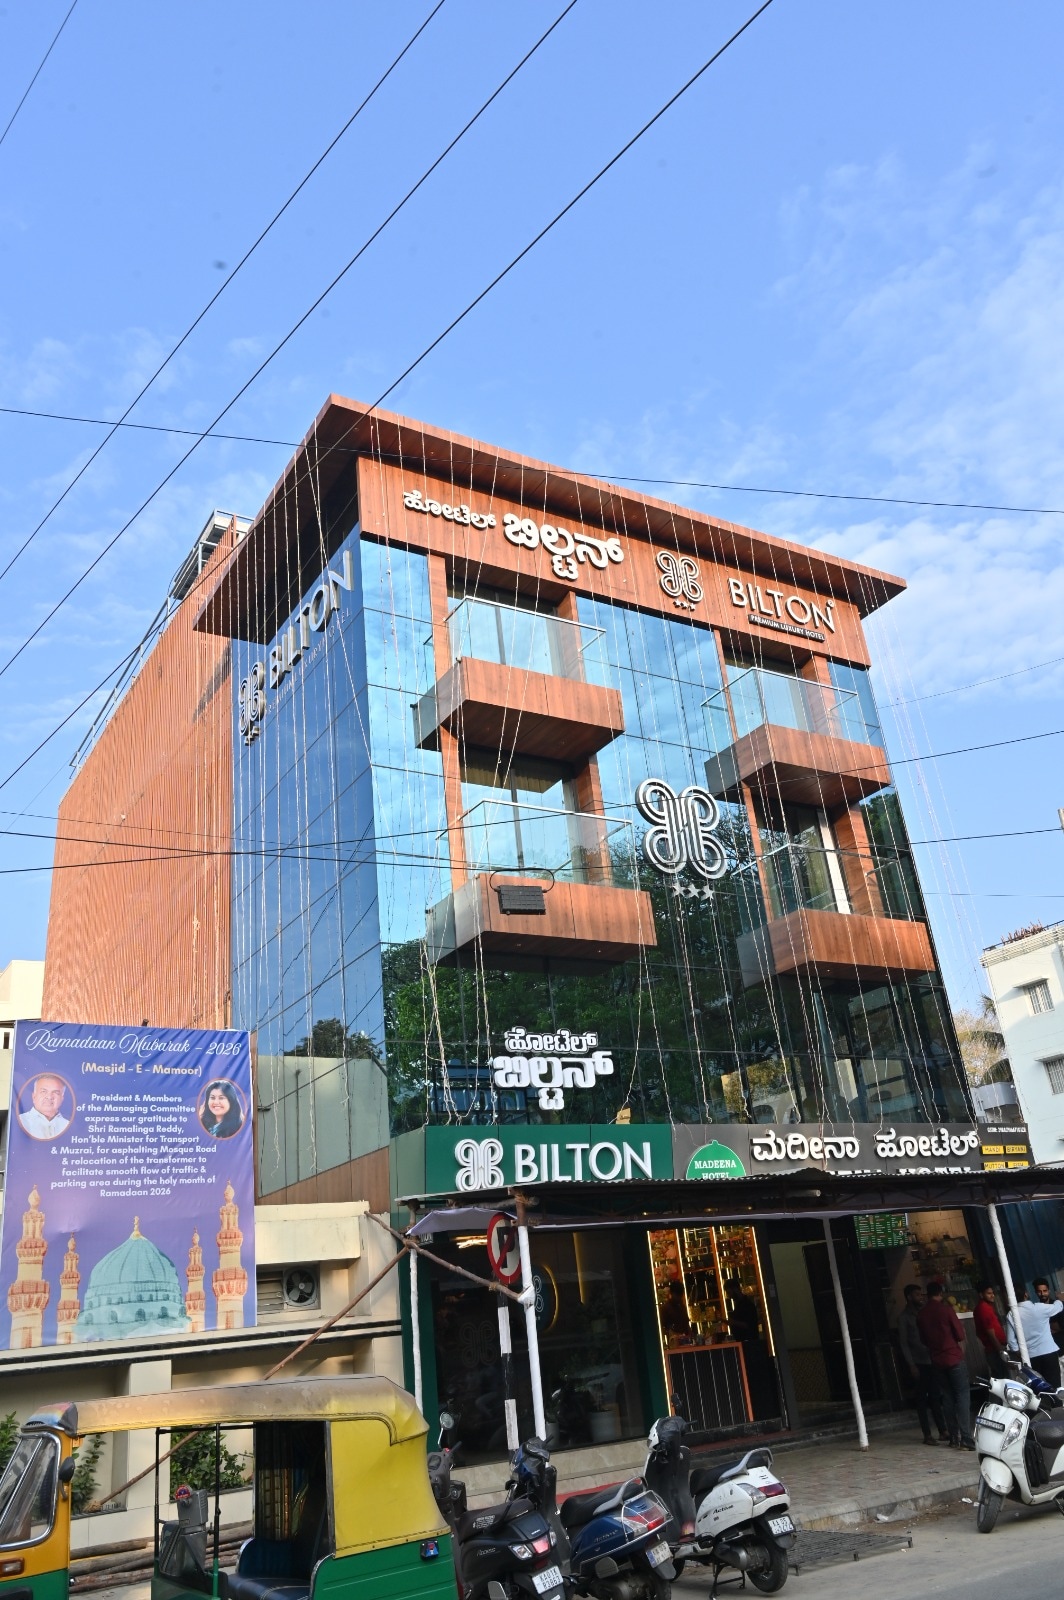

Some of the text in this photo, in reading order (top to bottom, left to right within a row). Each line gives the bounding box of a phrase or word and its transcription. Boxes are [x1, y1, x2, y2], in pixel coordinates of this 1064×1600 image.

[728, 578, 835, 633] BILTON
[269, 549, 354, 690] BILTON
[806, 630, 825, 640] HOTEL
[25, 1028, 117, 1053] Ramadaan
[119, 1033, 191, 1058] Mubarak
[205, 1041, 242, 1056] 2026
[504, 1026, 598, 1054] ಹೋಟೆಲ್
[81, 1061, 126, 1075] (Masjid
[136, 1064, 143, 1074] E
[152, 1064, 202, 1077] Mamoor)
[91, 1094, 182, 1102] President & Members
[76, 1104, 196, 1114] of the Managing Committee
[84, 1116, 120, 1124] express
[138, 1114, 178, 1124] gratitude
[88, 1124, 184, 1134] Shri Ramalinga Reddy,
[146, 1134, 159, 1142] for
[160, 1135, 200, 1144] Transport
[50, 1144, 217, 1156] & Muzrai, for asphalting Mosque Road
[70, 1156, 117, 1165] relocation
[119, 1156, 129, 1164] of
[130, 1156, 144, 1164] the
[146, 1155, 197, 1164] transformer
[514, 1142, 652, 1182] BILTON
[694, 1160, 737, 1169] MADEENA
[62, 1168, 104, 1176] facilitate
[105, 1166, 139, 1176] smooth
[140, 1166, 160, 1174] flow
[161, 1166, 171, 1174] of
[172, 1165, 199, 1174] traffic
[50, 1178, 87, 1190] parking
[112, 1178, 142, 1188] during
[144, 1177, 158, 1185] the
[160, 1176, 178, 1186] holy
[180, 1175, 206, 1184] month
[207, 1174, 216, 1183] of
[100, 1188, 171, 1197] Ramadaan 2026
